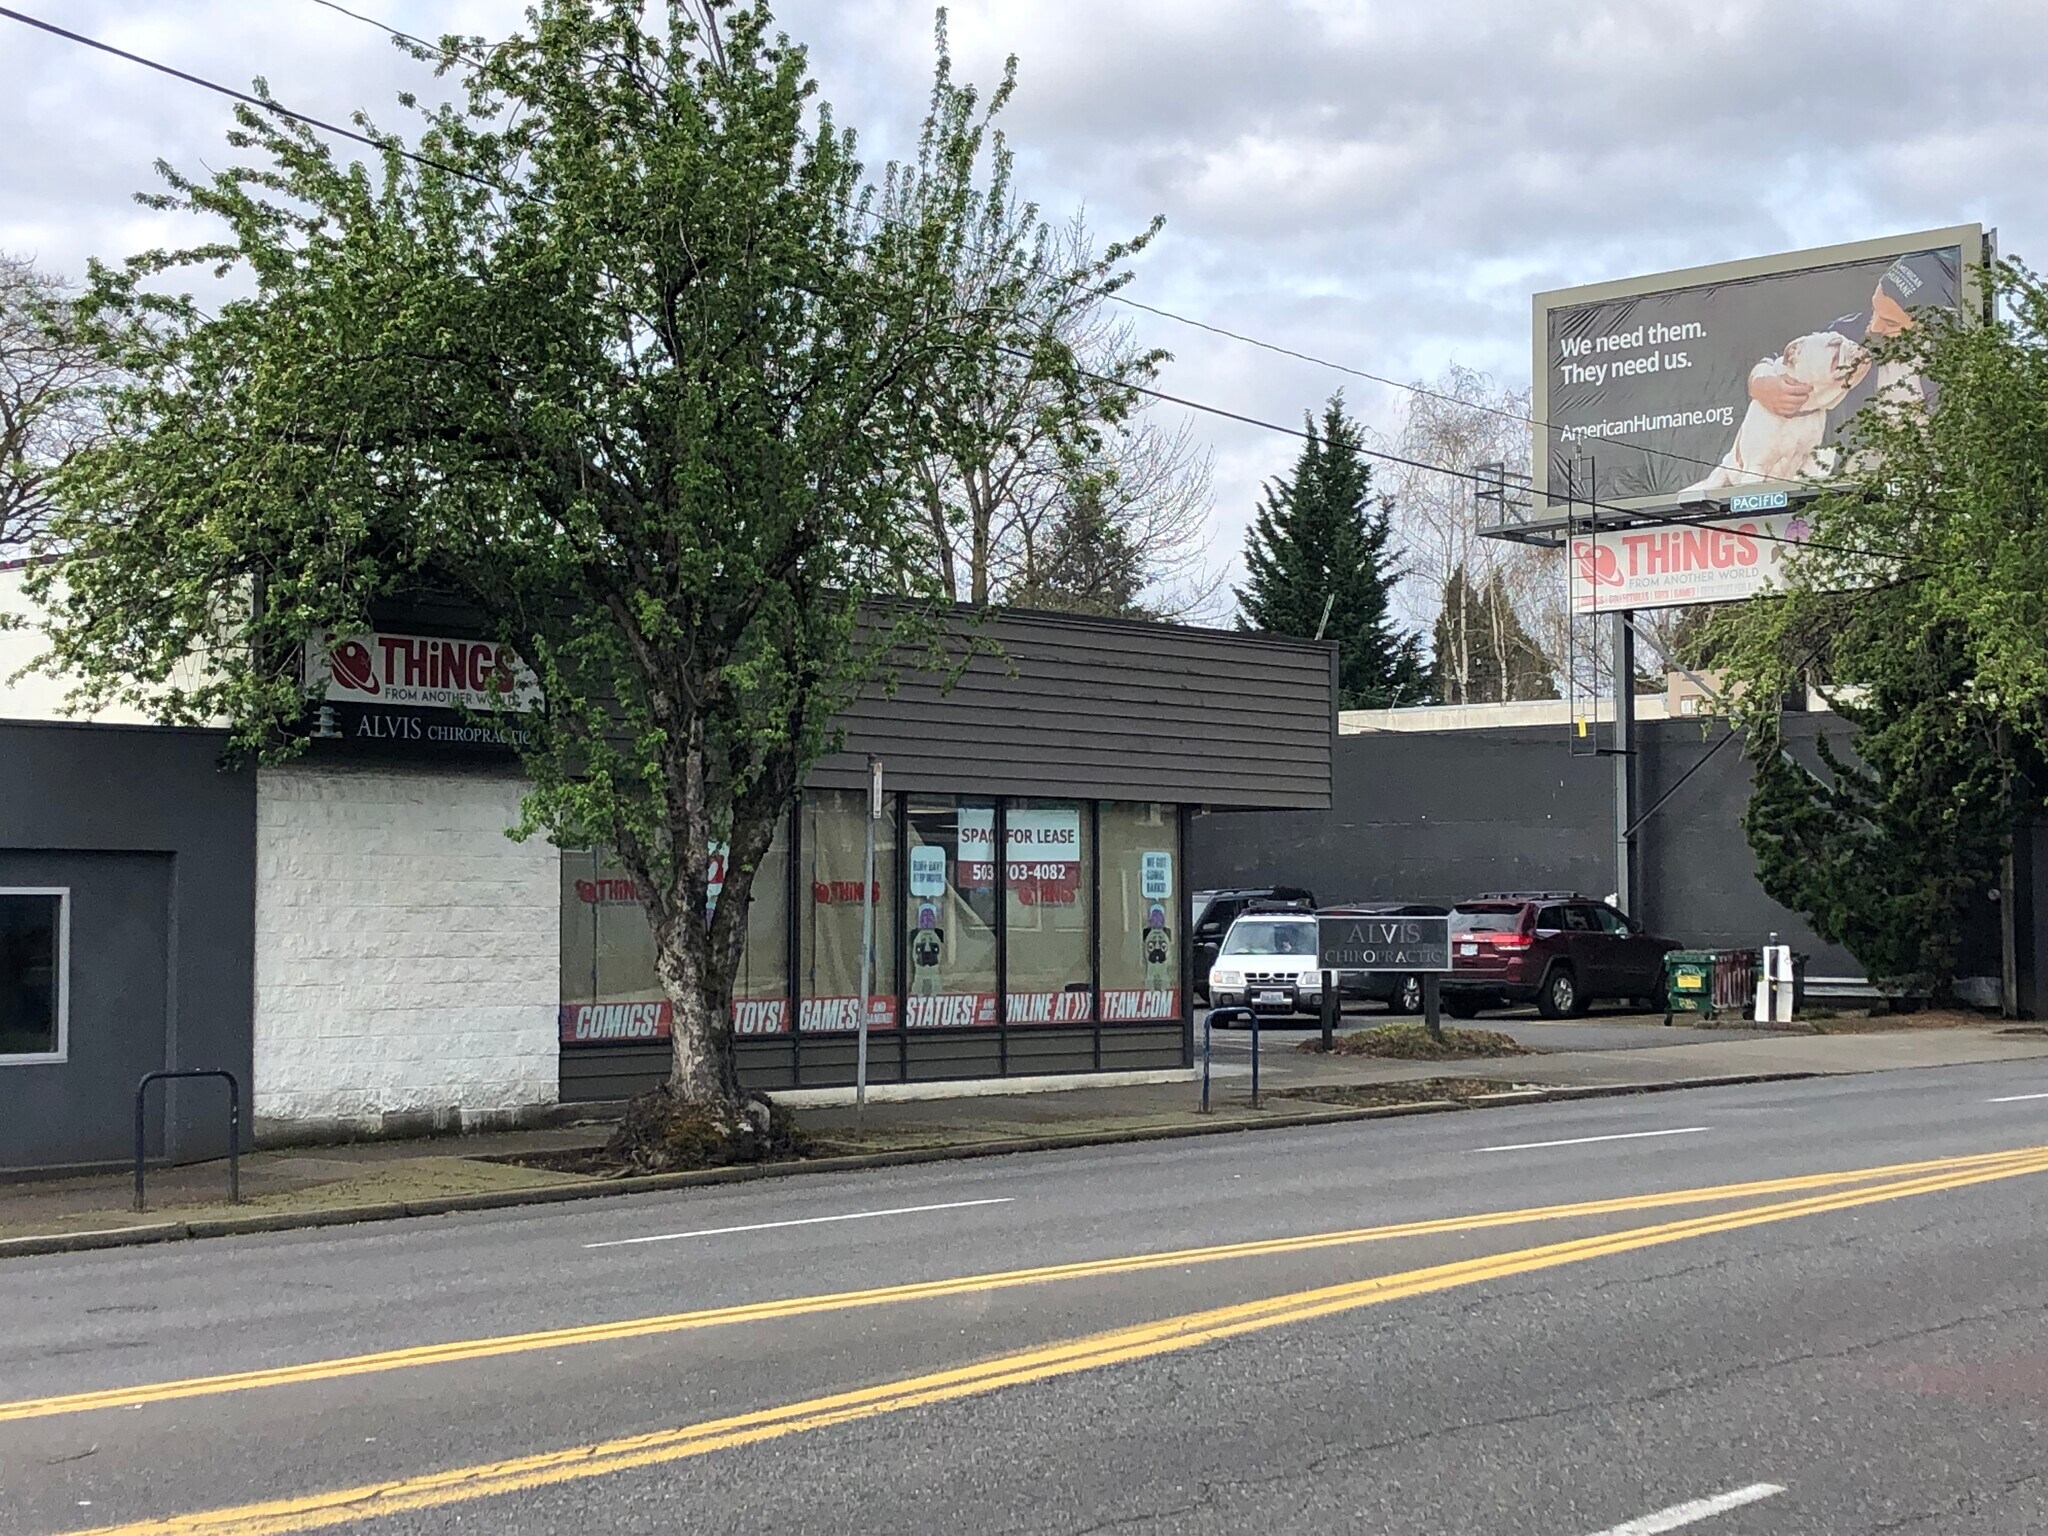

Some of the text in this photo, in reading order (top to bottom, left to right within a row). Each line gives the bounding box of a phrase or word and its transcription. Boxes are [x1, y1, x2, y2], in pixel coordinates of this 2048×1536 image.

[1887, 271, 1913, 298] HUMANE
[1561, 322, 1707, 358] We need them.
[1561, 351, 1693, 386] They need us.
[1560, 406, 1734, 442] AmericanHumane.org
[1629, 567, 1759, 589] FROM ANOTHER WORLD
[385, 689, 417, 701] FROM
[421, 691, 473, 705] ANOTHER
[356, 714, 422, 740] ALVIS
[1006, 829, 1033, 844] FOR
[1037, 829, 1075, 844] LEASE
[1346, 923, 1421, 944] ALVIS
[1325, 950, 1442, 963] CHIROPRACTIC
[734, 1000, 785, 1034] TOYS!
[799, 998, 861, 1031] GAMES!
[906, 995, 978, 1027] STATUES!
[1006, 993, 1053, 1023] ONLINE
[1054, 992, 1073, 1020] AT
[1103, 991, 1174, 1019] TFAW.COM
[576, 1003, 662, 1039] COMICS!
